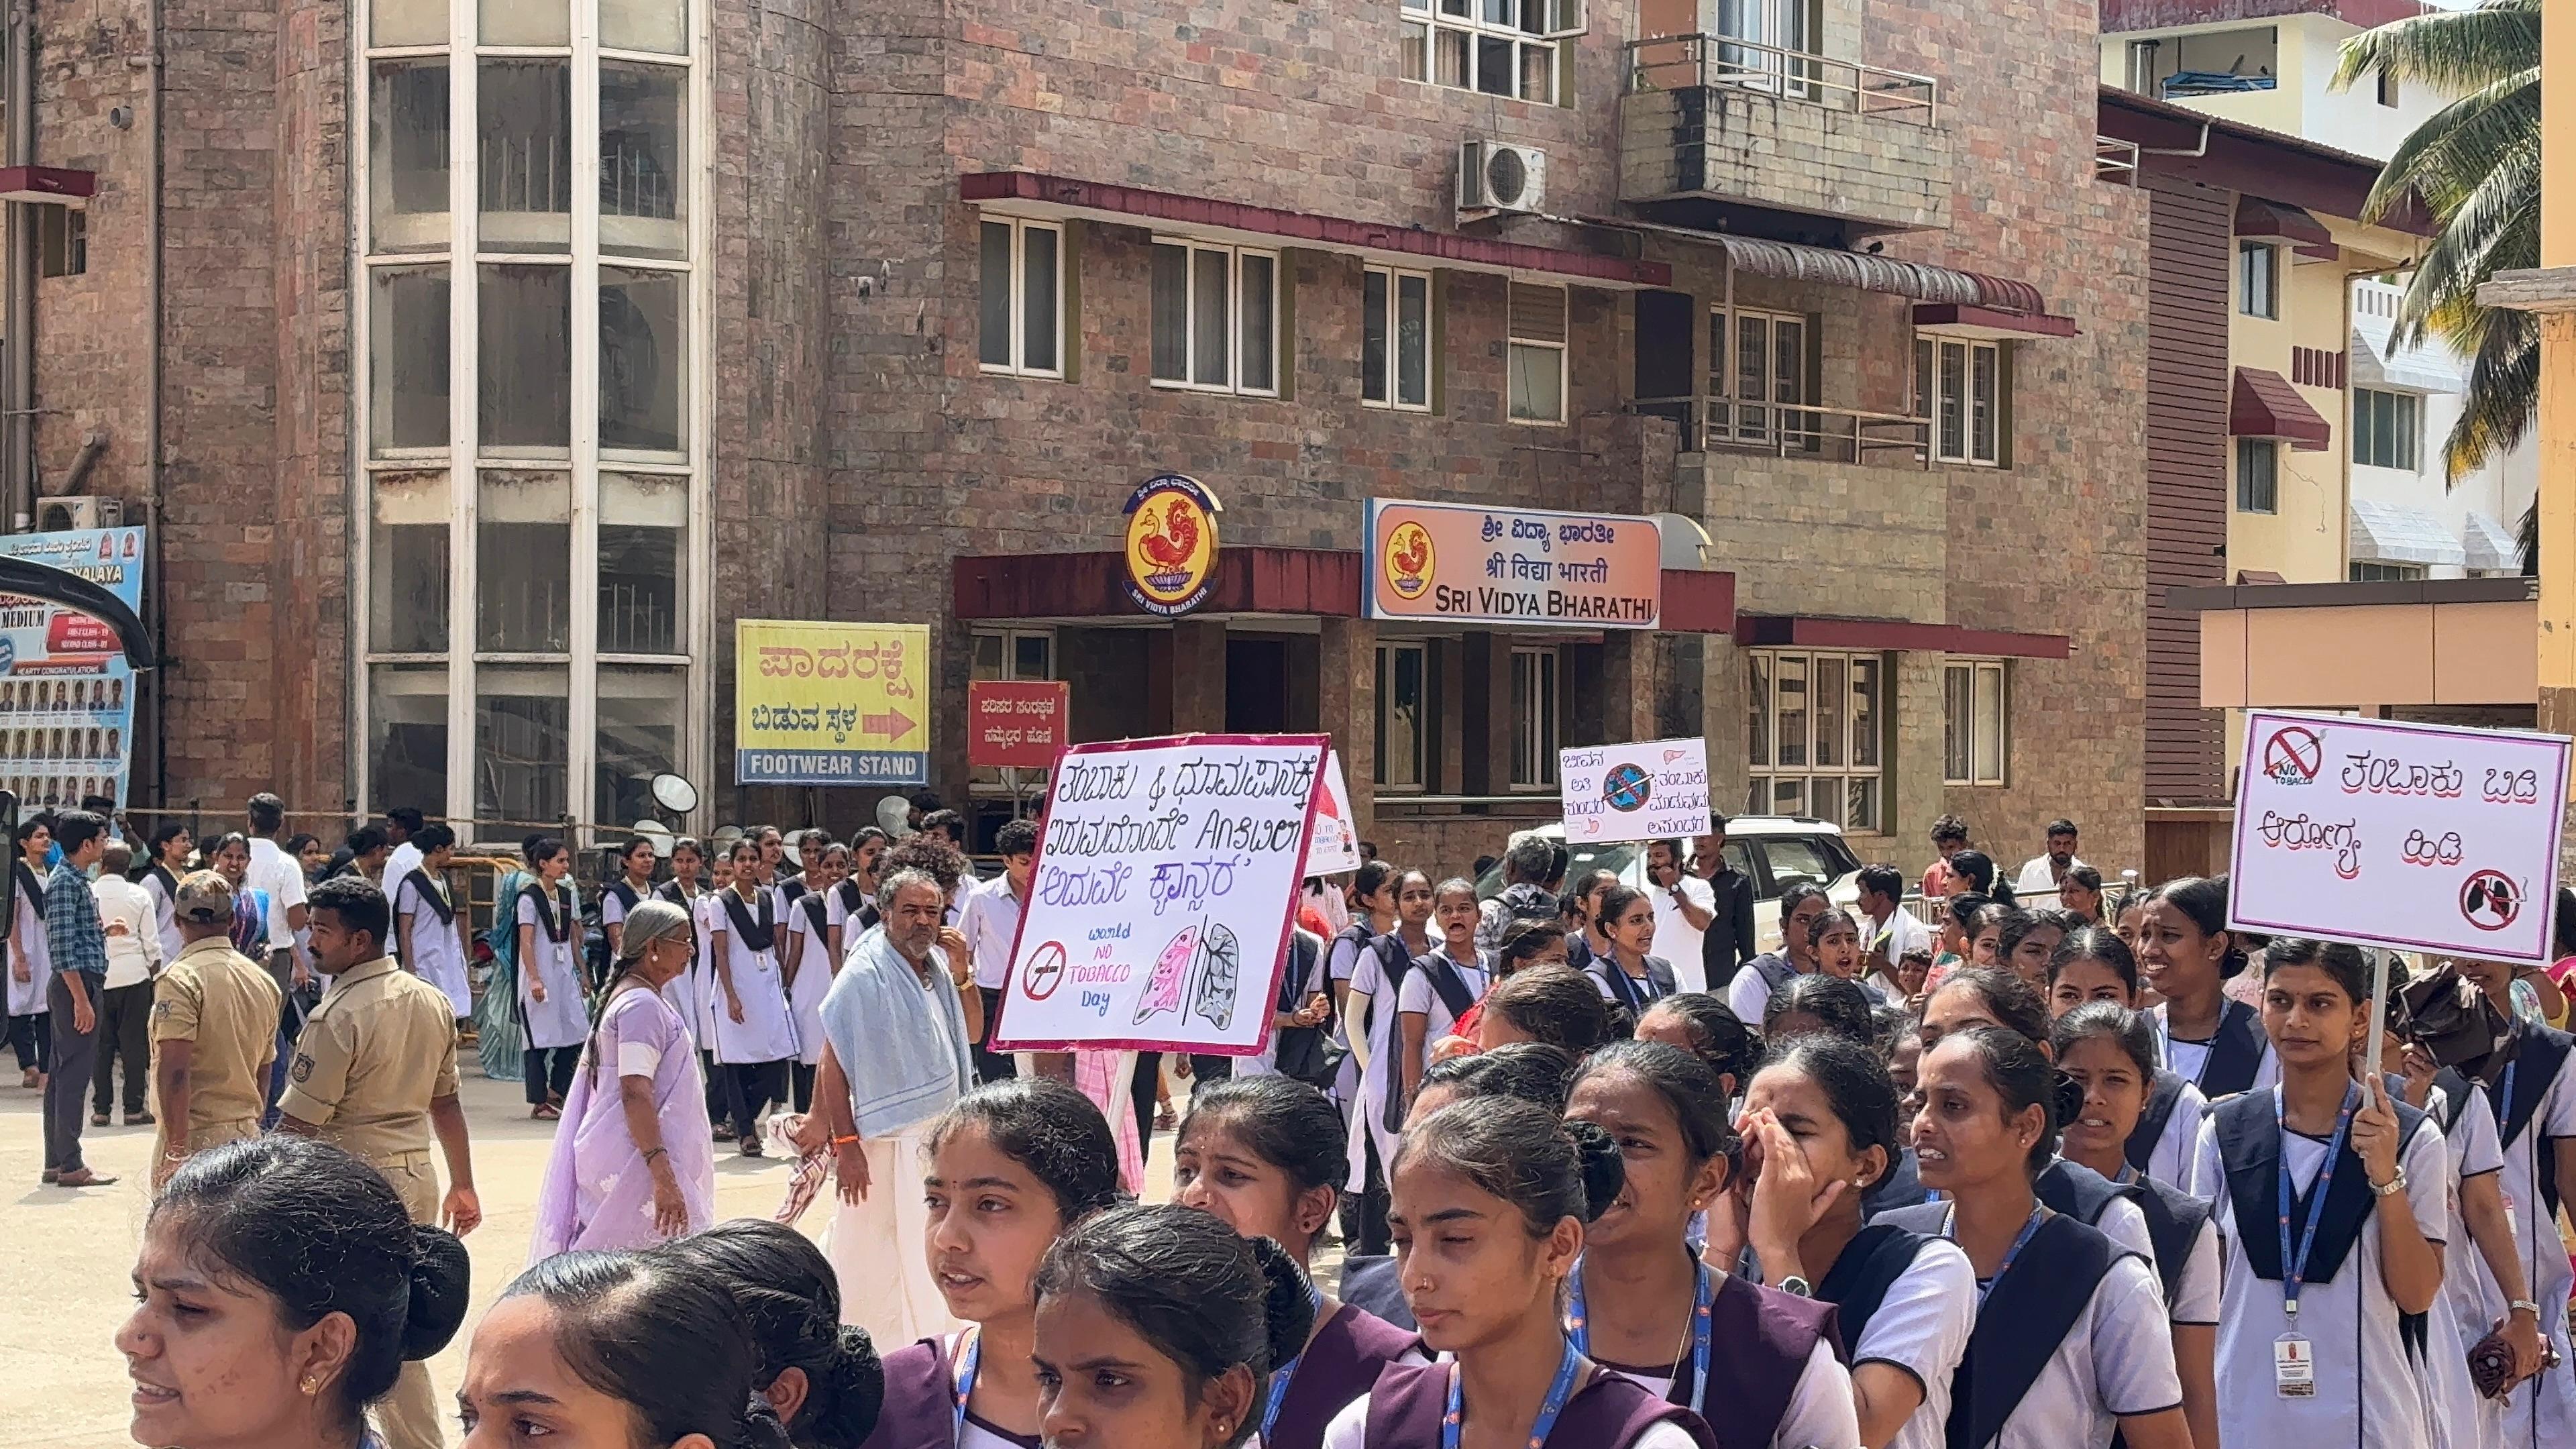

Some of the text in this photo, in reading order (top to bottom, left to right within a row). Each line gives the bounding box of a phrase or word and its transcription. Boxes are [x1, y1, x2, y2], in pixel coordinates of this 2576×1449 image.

[1481, 515, 1615, 553] ಶ್ರೀ ವಿದ್ಯಾ ಭಾರತೀ
[66, 566, 123, 584] YALAYA
[1486, 552, 1608, 584] श्री विद्या भारती
[1132, 587, 1208, 614] SRI VIDYA BHARATHI
[1435, 584, 1652, 621] SRI VIDYA BHARATHI
[1, 610, 45, 629] MEDIUM
[759, 640, 914, 699] ಪಾದರಕ್ಷೆ
[751, 702, 857, 743] ಬಿಡುವ ಸ್ಥಳ
[751, 753, 916, 775] FOOTWEAR STAND
[1563, 750, 1604, 768] ಜೀವನ
[2279, 764, 2297, 775] NO
[1059, 758, 1138, 802] ತಂಬಾಕು
[2274, 776, 2313, 786] TOBACCO
[2341, 749, 2463, 798] ತಂಬಾಕು
[2257, 810, 2361, 879] ಆರೋಗ್ಯ
[1093, 944, 1112, 961] NO
[1069, 964, 1130, 984] TOBACCO
[1081, 990, 1110, 1017] Day
